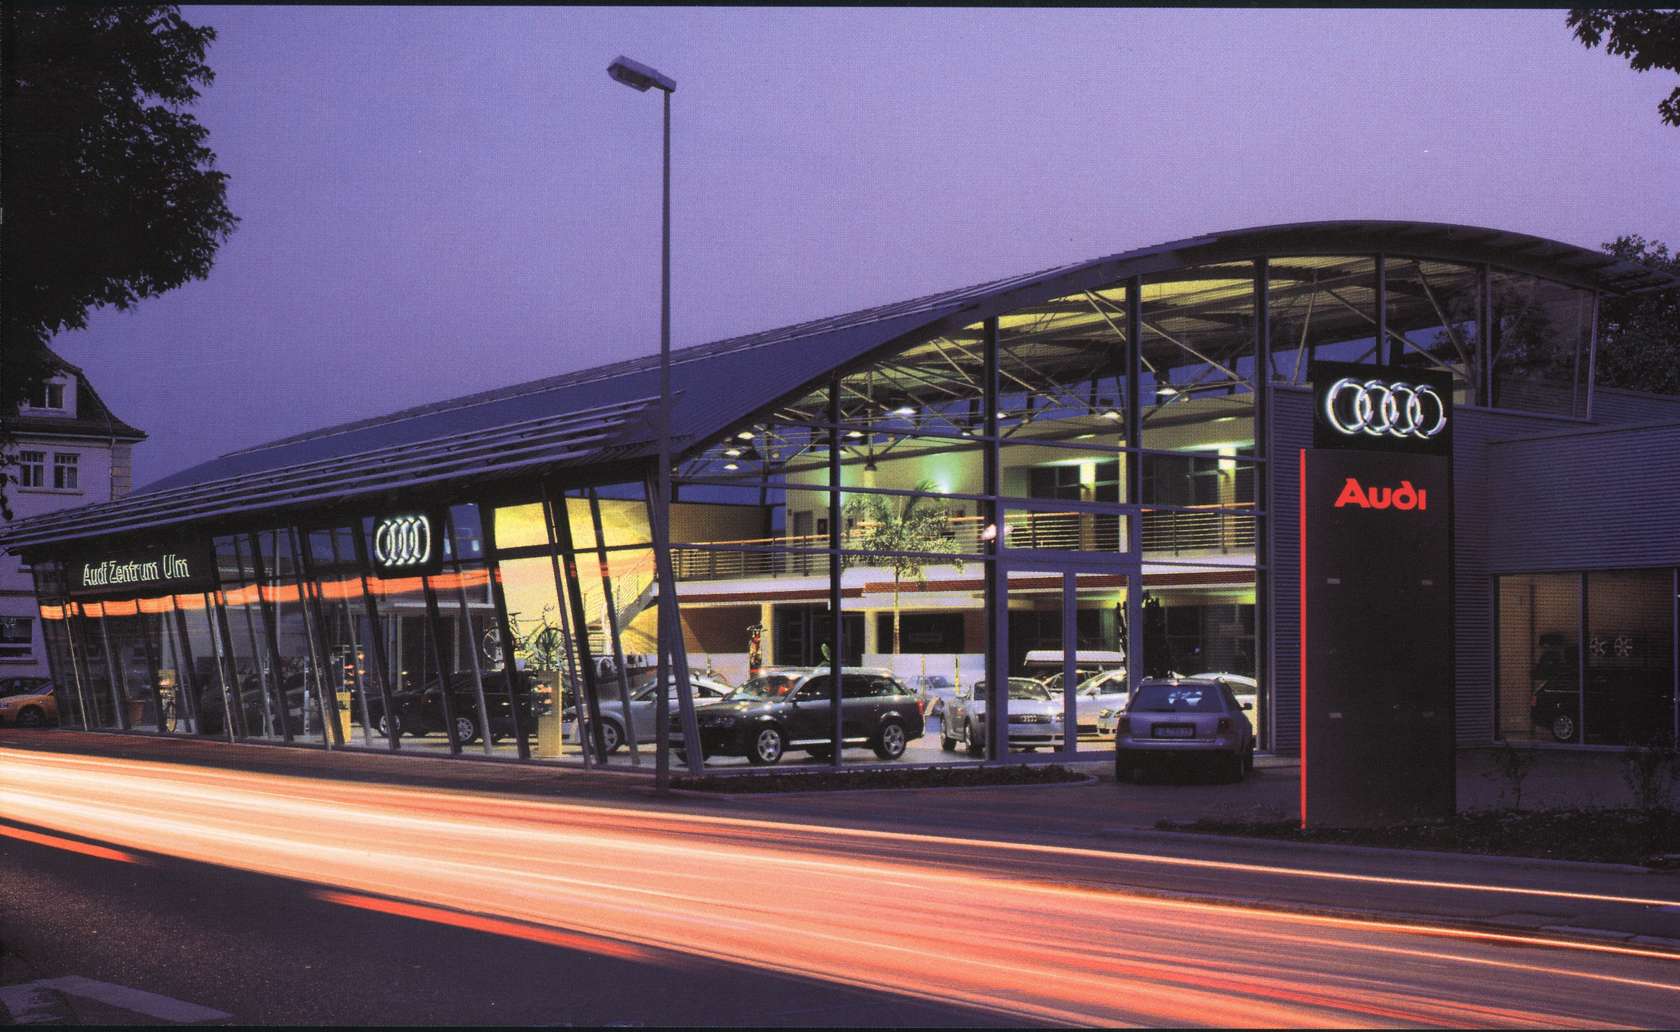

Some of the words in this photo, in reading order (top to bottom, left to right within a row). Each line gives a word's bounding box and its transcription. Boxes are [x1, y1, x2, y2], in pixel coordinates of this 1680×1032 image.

[1334, 477, 1427, 511] Audi
[83, 561, 108, 586] Audi
[109, 560, 160, 584] Zentrum
[163, 553, 190, 579] Ulm
